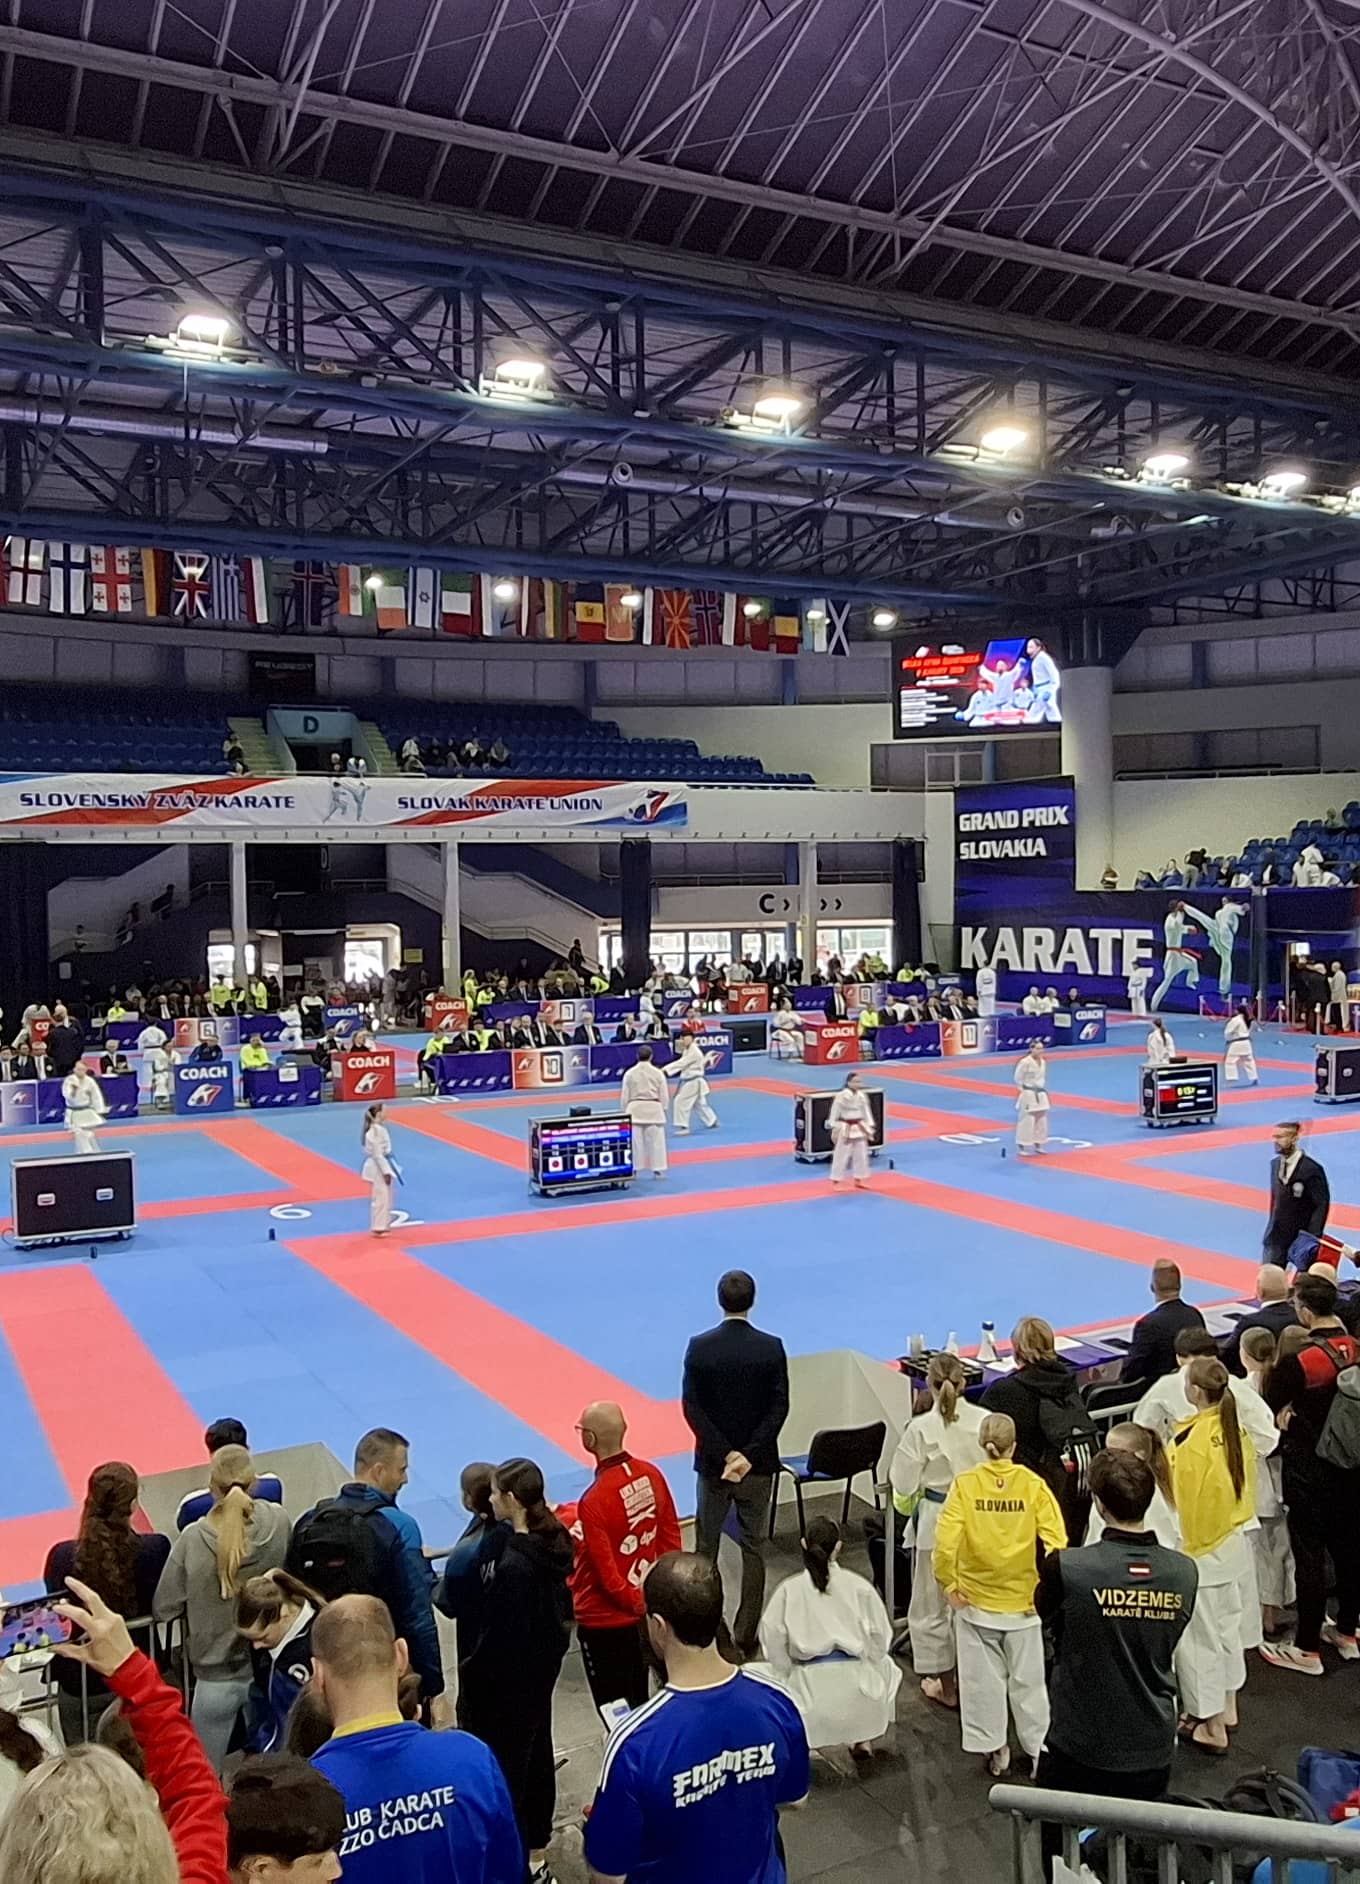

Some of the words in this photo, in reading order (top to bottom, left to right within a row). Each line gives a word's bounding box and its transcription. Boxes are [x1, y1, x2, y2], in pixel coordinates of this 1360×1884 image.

[303, 716, 319, 734] D
[214, 793, 295, 809] KARATE
[398, 795, 472, 811] SLOVAK
[476, 796, 546, 811] KARATE
[549, 797, 603, 811] UNION
[959, 808, 1020, 832] GRAND
[1022, 805, 1070, 828] PRIX
[959, 837, 1048, 860] SLOVAKIA
[759, 893, 775, 914] C
[960, 926, 1154, 979] KARATE
[327, 1007, 358, 1017] COACH
[434, 1000, 465, 1010] COACH
[822, 1026, 855, 1038] COACH
[347, 1056, 390, 1069] COACH
[546, 1057, 560, 1076] 10
[179, 1066, 228, 1080] COACH
[390, 1209, 425, 1228] 2
[975, 1499, 1025, 1513] SLOVAKIA
[1092, 1588, 1183, 1610] VIDZEMES
[380, 1786, 455, 1821] KARATE
[377, 1810, 445, 1840] ČADCA
